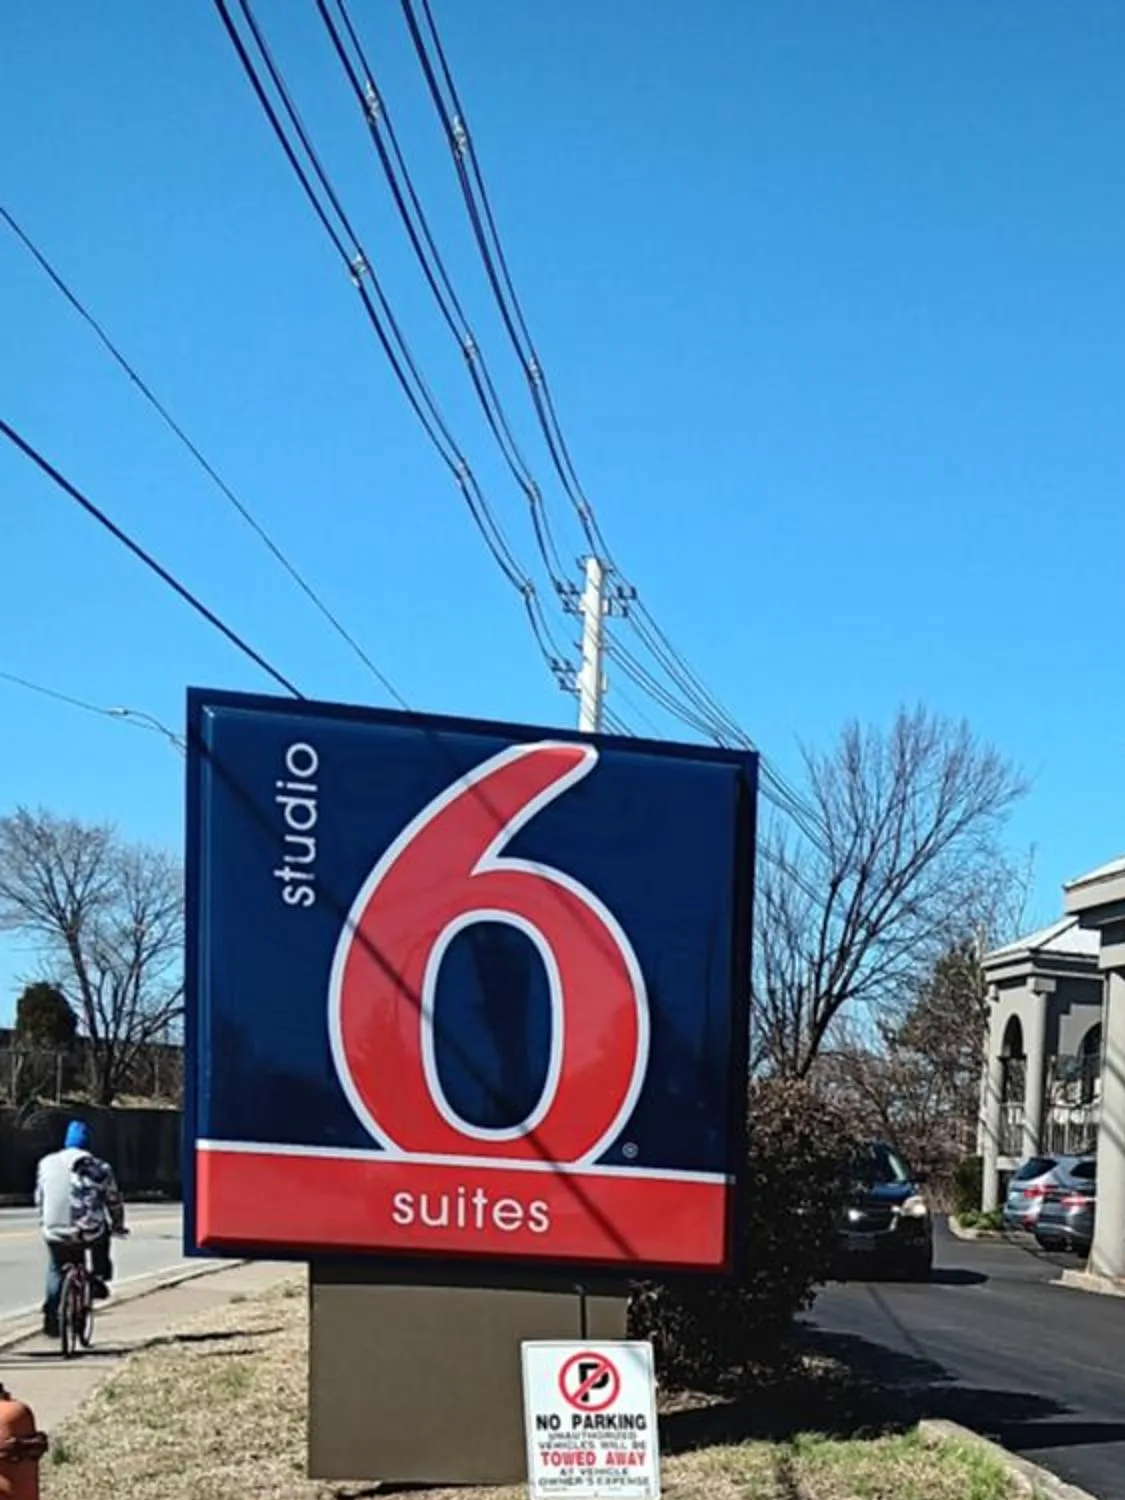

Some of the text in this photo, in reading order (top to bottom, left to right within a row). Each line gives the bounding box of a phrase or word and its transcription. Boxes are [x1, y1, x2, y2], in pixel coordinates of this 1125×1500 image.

[273, 742, 319, 907] studio
[328, 740, 651, 1165] 6
[392, 1186, 549, 1233] suites
[536, 1413, 647, 1430] NO PARKING
[540, 1451, 646, 1467] TOWED AWAY
